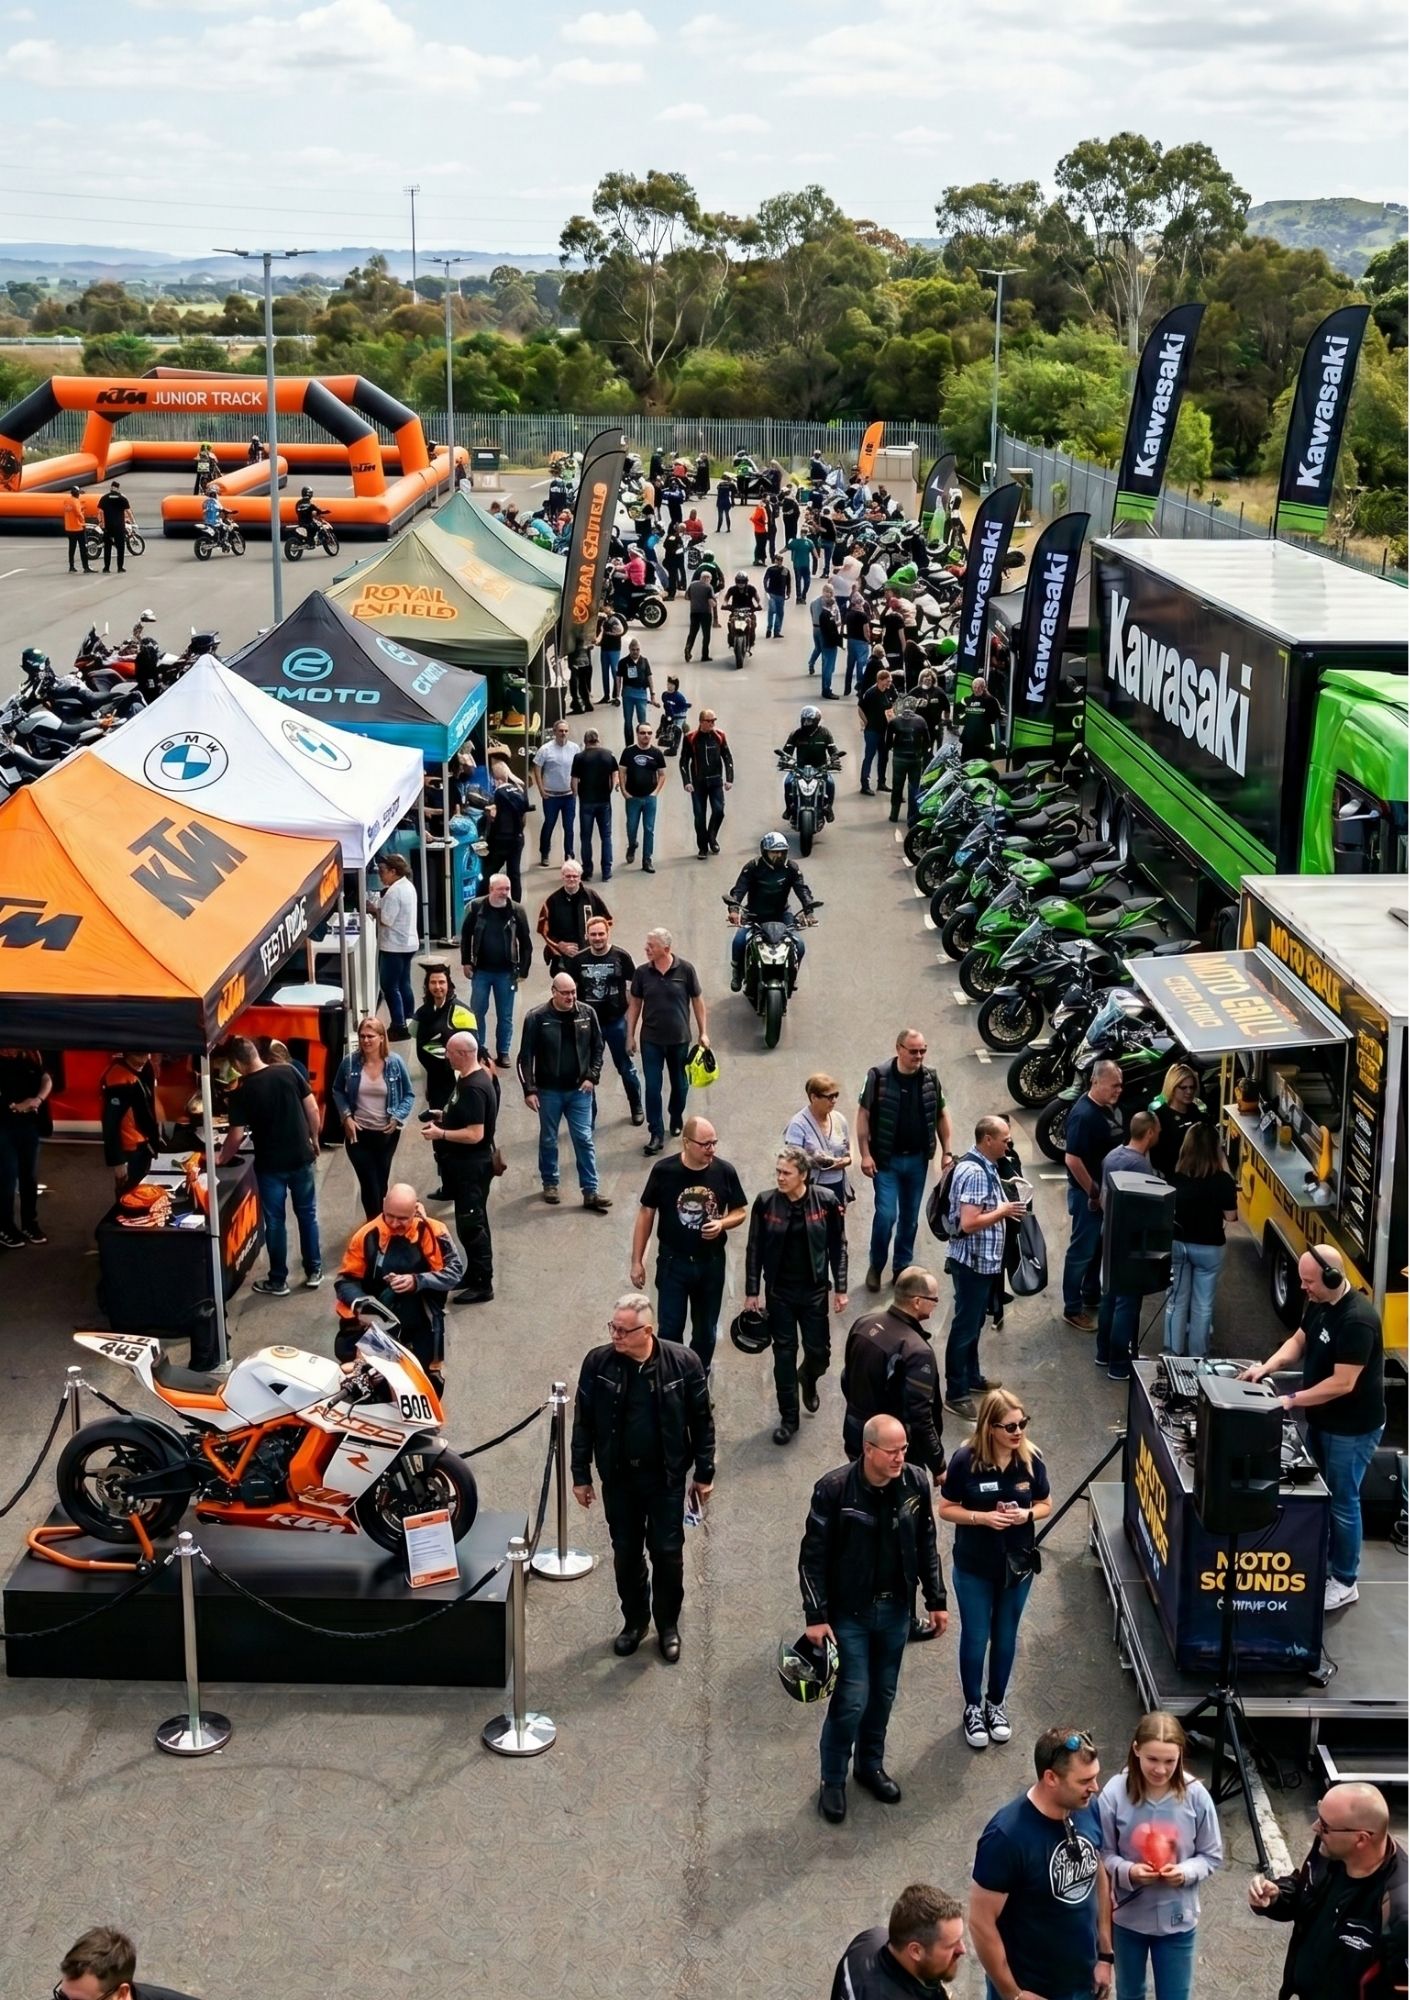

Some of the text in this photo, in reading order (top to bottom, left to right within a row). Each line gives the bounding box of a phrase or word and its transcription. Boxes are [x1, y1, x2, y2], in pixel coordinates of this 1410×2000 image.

[96, 388, 262, 405] KTM JUNIOR TRACK
[1134, 333, 1186, 477] Kawasaki
[1296, 335, 1349, 488] Kawasaki
[351, 602, 457, 620] ENFIELD
[363, 585, 446, 604] ROYAL
[964, 520, 1003, 657] Kawasaki
[1026, 552, 1069, 703] Kawasaki
[1107, 589, 1254, 778] Kawasaki
[126, 817, 248, 920] KTM
[0, 896, 84, 952] TM
[1270, 918, 1305, 977] MOTO
